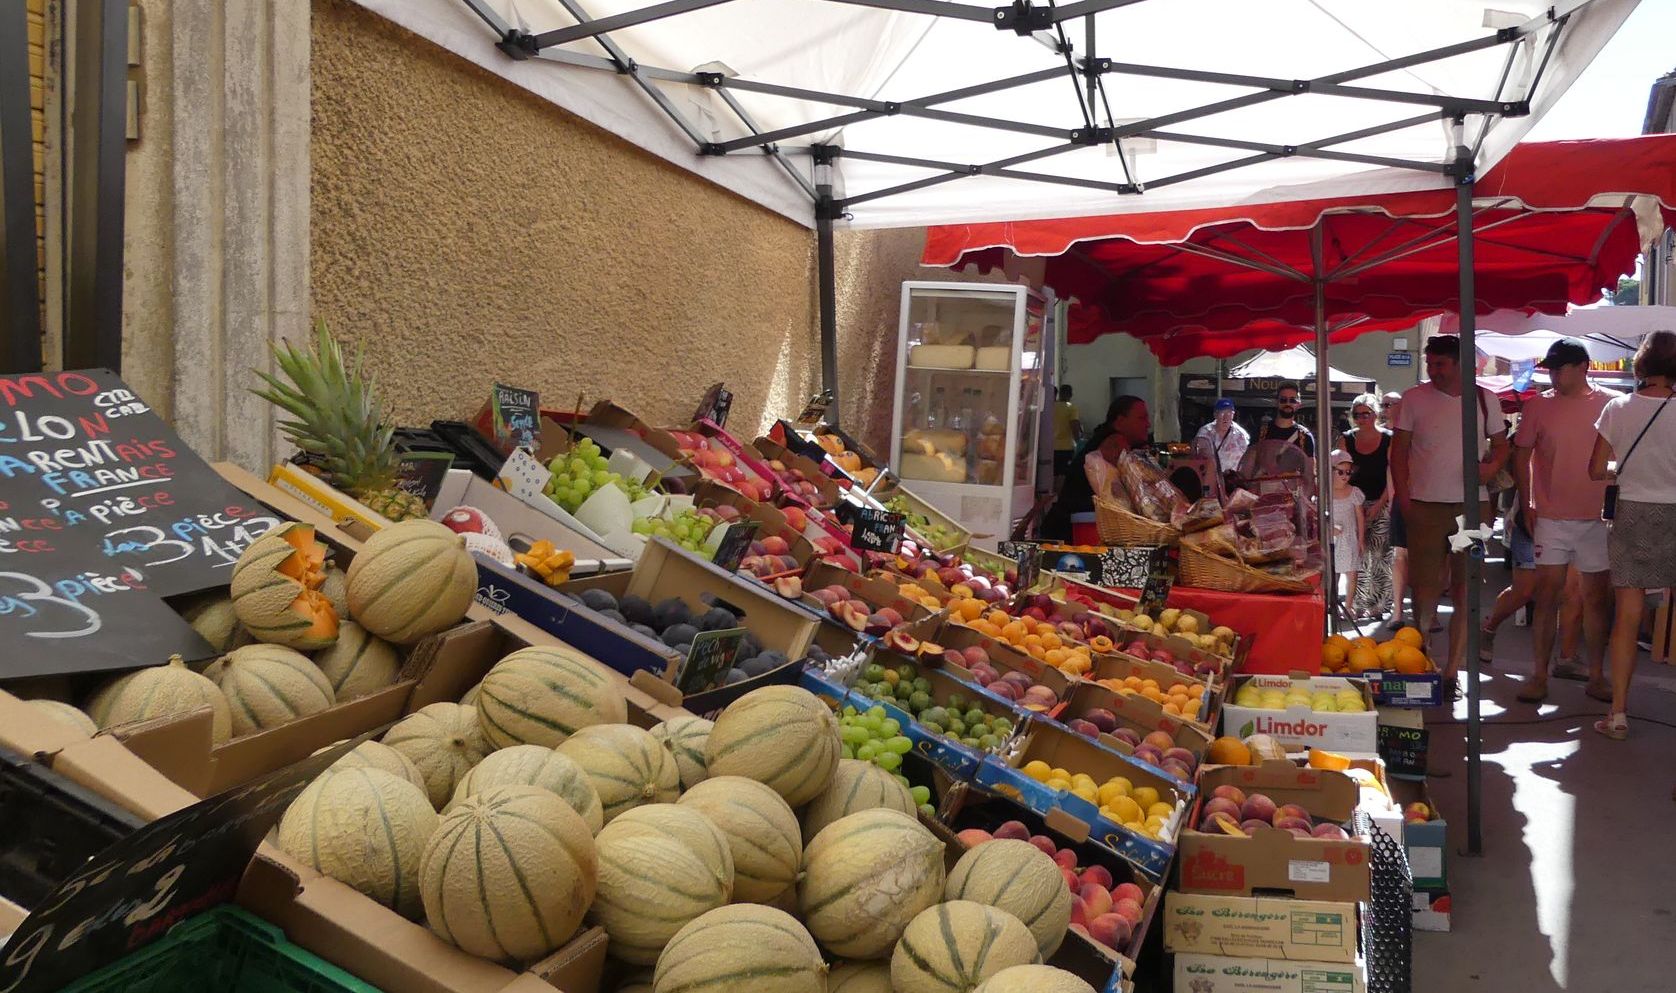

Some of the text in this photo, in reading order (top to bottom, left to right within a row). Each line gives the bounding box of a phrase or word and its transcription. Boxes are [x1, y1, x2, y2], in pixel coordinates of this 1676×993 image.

[0, 372, 99, 407] MO
[1250, 378, 1280, 392] Nou
[0, 410, 112, 441] LON
[1258, 679, 1293, 689] Limdor
[1256, 716, 1328, 737] Limdor
